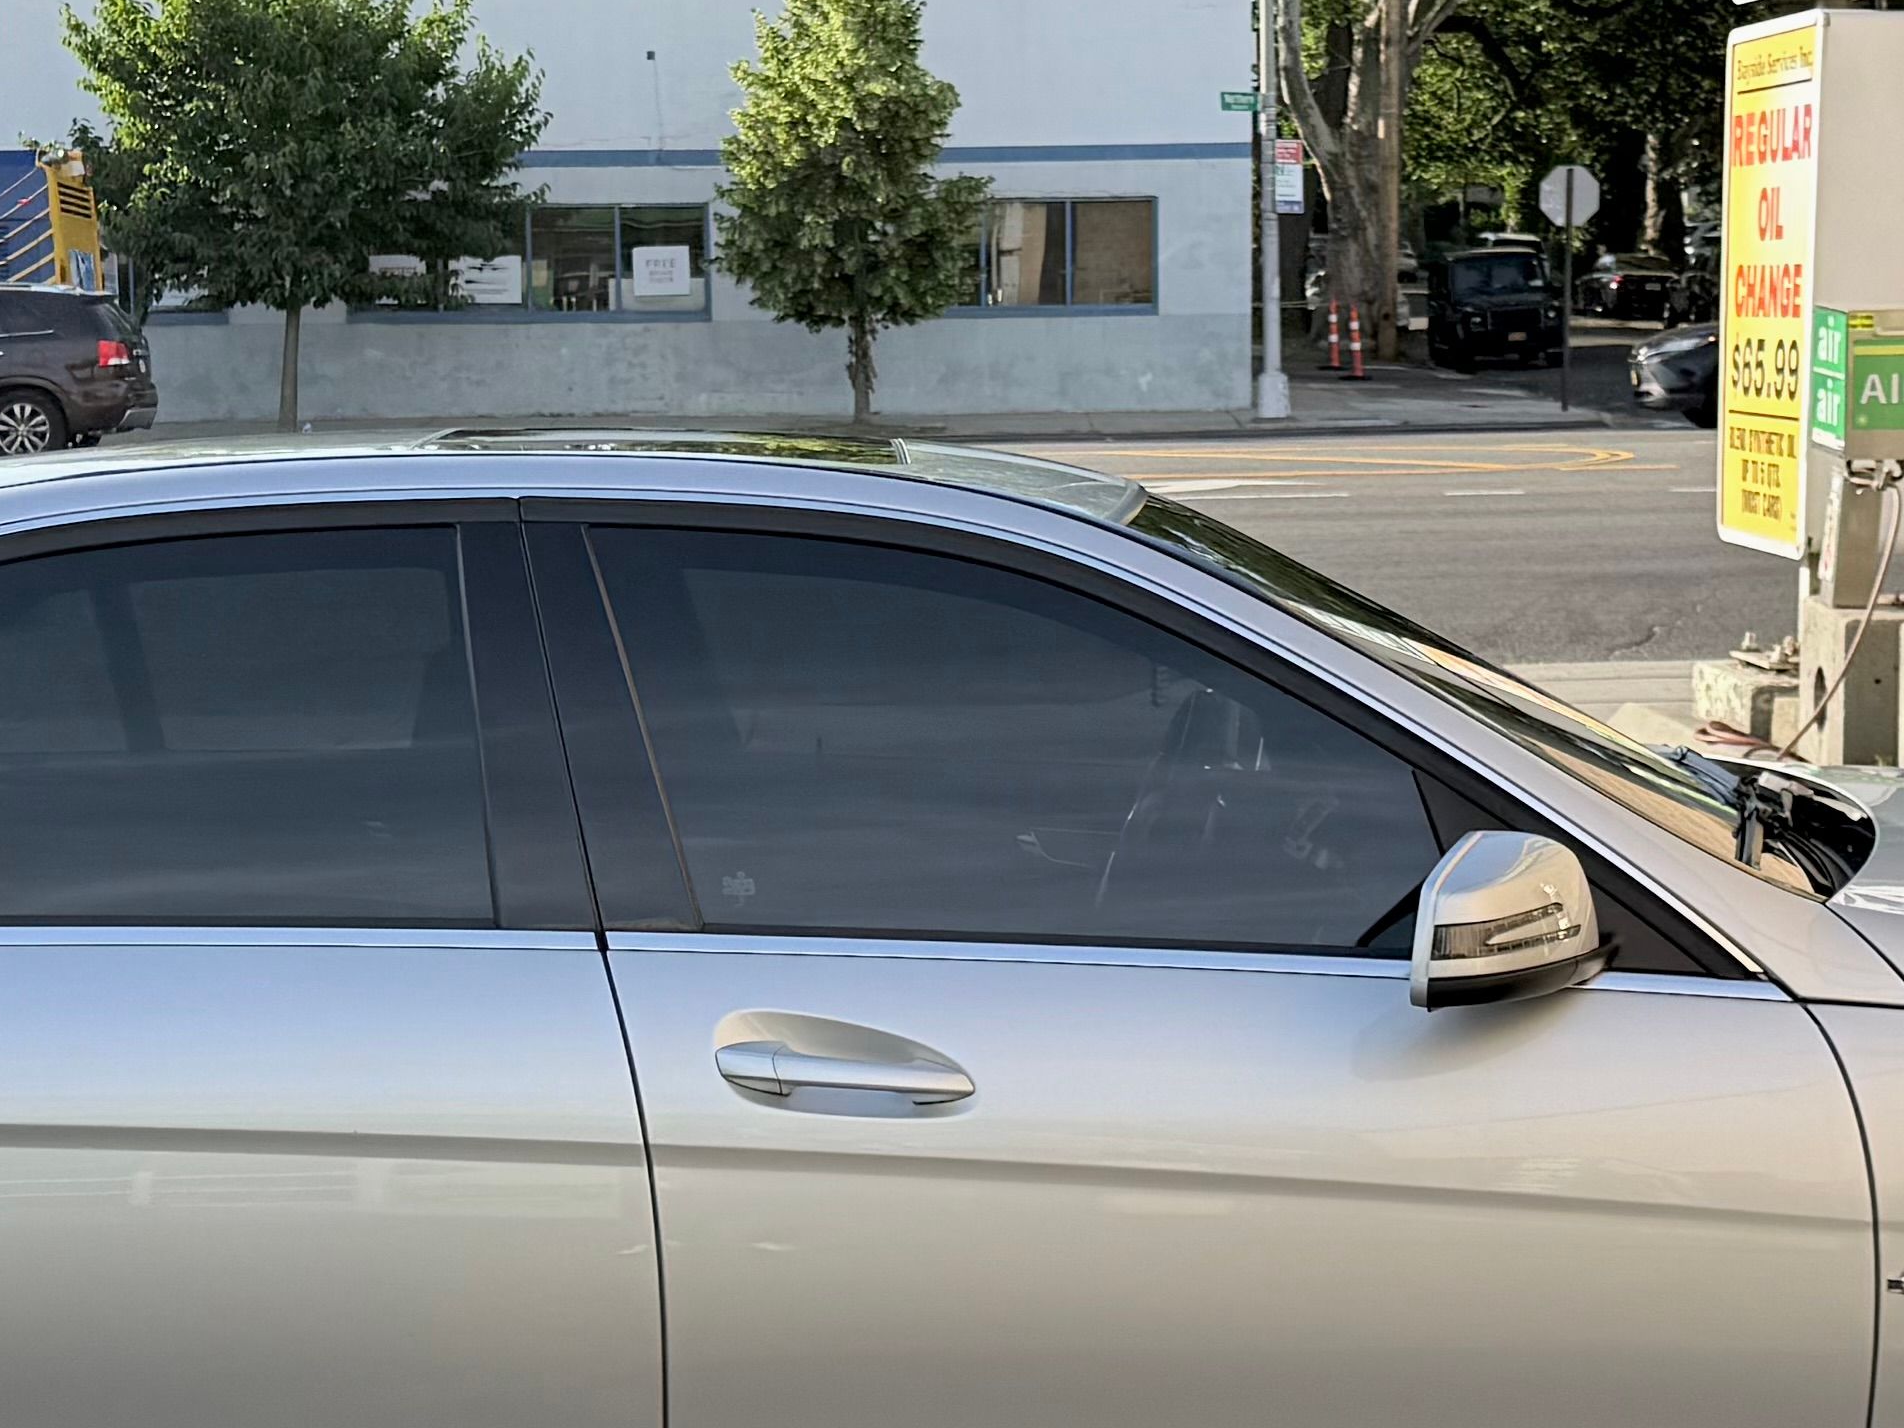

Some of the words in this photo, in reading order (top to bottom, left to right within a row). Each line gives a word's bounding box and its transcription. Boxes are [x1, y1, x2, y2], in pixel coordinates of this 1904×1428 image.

[1732, 103, 1813, 168] REGULAR
[1758, 186, 1784, 242] OIL
[1735, 263, 1804, 319] CHANGE
[1731, 333, 1800, 402] $65.99
[1817, 315, 1842, 365] air
[1816, 378, 1841, 427] air
